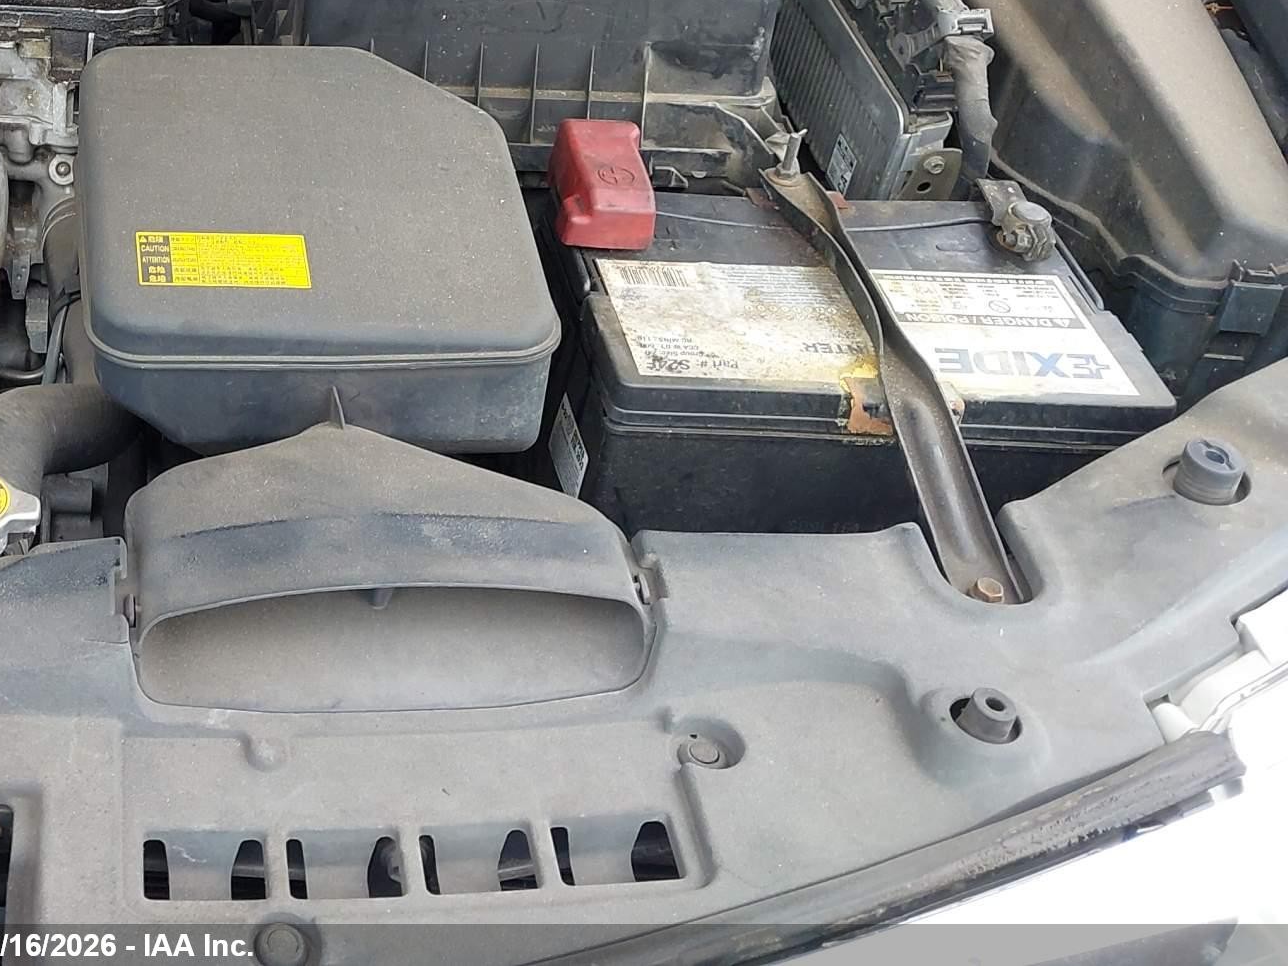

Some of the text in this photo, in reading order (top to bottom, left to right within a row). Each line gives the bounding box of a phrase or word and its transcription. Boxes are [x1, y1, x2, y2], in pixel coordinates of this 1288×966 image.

[140, 244, 169, 253] CAUTION
[142, 256, 170, 264] ATTENTION
[902, 313, 970, 325] POISON
[981, 316, 1054, 328] DANGER
[712, 359, 739, 370] Part
[934, 347, 1111, 381] EXIDE
